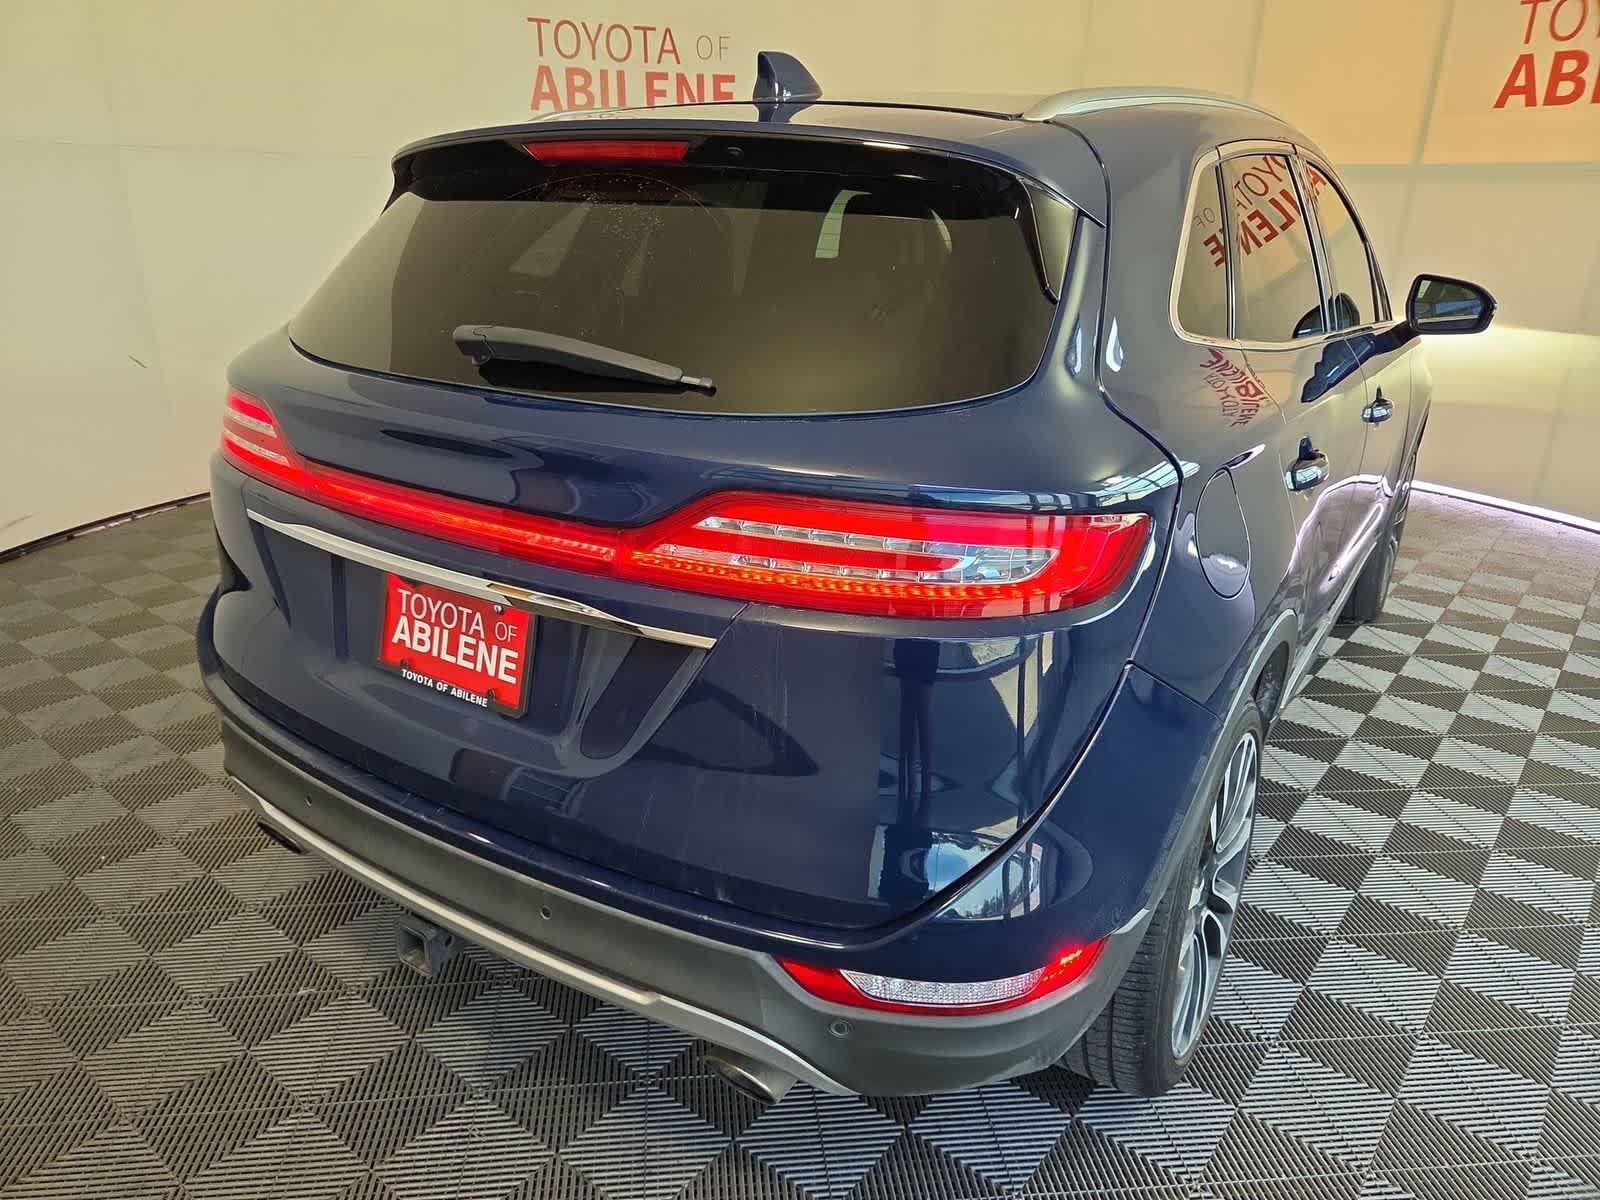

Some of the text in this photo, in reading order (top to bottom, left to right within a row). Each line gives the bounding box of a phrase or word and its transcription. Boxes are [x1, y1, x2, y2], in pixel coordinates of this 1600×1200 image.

[527, 16, 730, 65] TOYOTA OF
[1520, 0, 1600, 44] TO
[397, 588, 518, 643] TOYOTA OF
[391, 615, 519, 684] ABILENE
[401, 668, 488, 708] TOYOTA OF ABILENE
